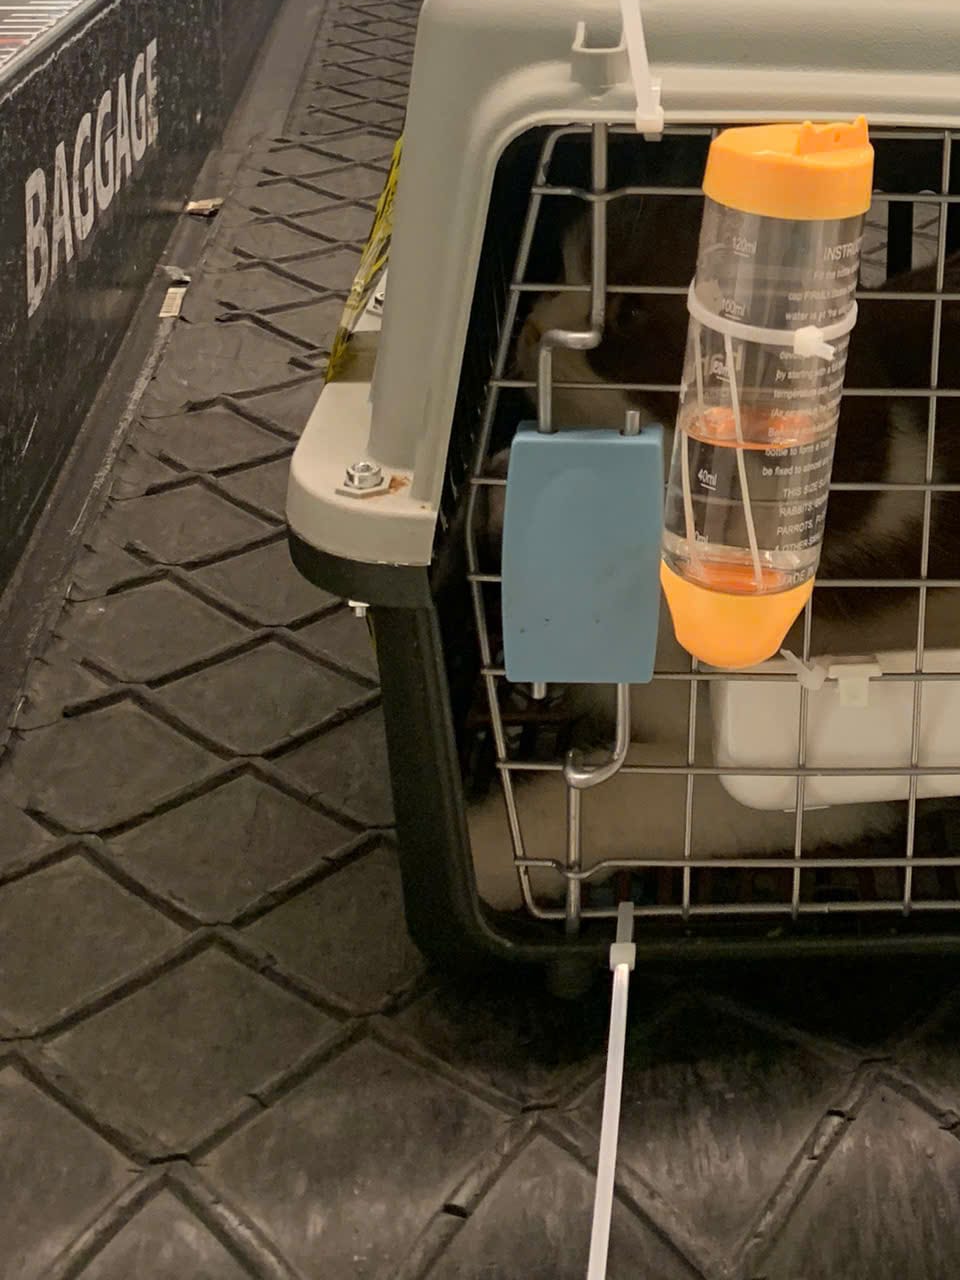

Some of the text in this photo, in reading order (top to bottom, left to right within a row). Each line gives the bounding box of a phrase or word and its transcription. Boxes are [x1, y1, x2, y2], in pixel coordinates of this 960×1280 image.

[25, 37, 160, 318] BAGGAGE
[732, 237, 757, 255] 120ml
[697, 467, 718, 487] 40ml
